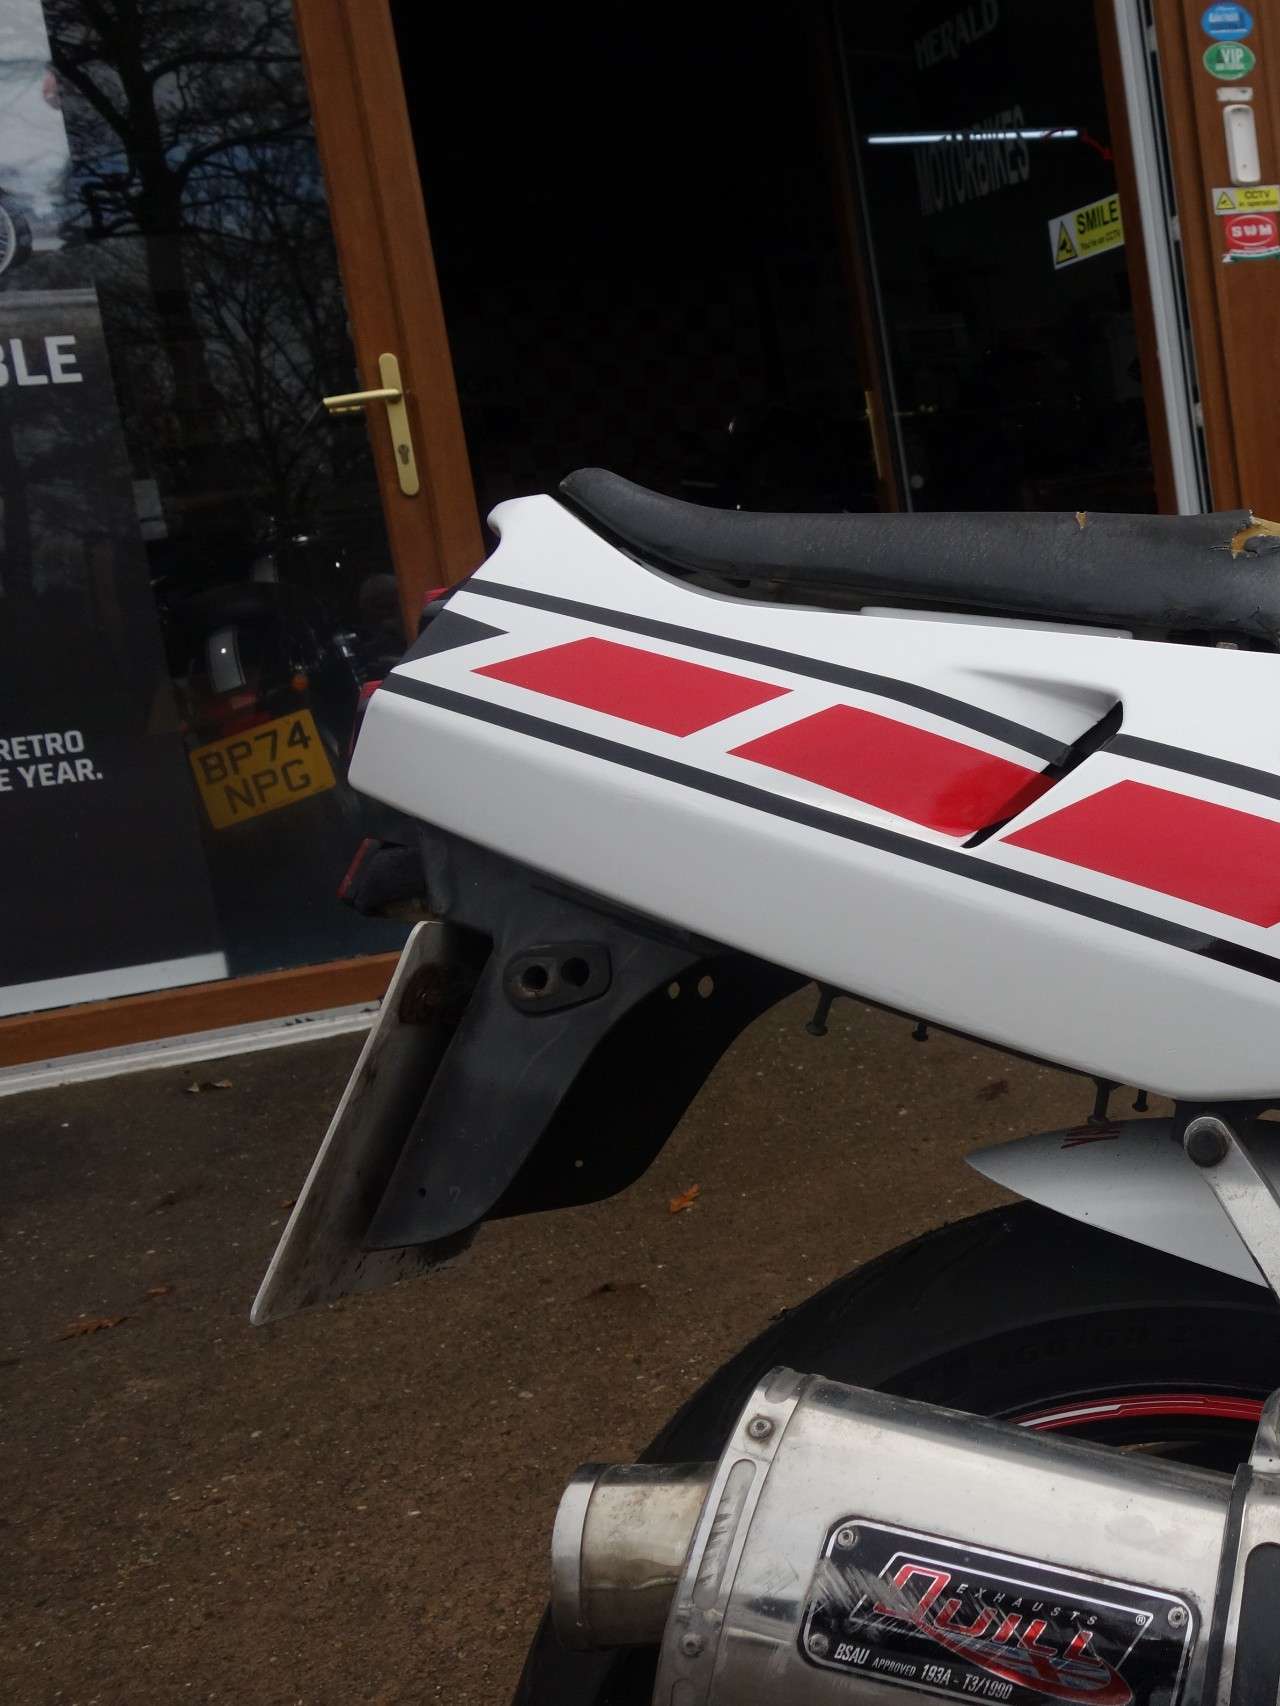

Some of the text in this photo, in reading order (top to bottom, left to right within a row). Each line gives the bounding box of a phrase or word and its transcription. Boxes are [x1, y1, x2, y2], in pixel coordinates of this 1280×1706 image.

[912, 0, 1000, 72] HERALD
[1221, 47, 1244, 64] VIP
[914, 104, 1031, 217] MOTORBIKES
[1244, 190, 1271, 200] CCTV
[1076, 200, 1119, 234] SMILE
[1231, 223, 1274, 238] SWM
[0, 335, 83, 387] LE
[17, 759, 104, 789] YEAR.
[198, 720, 311, 785] BP74
[224, 759, 312, 815] NPG
[955, 1583, 1099, 1626] EXHAUSTS
[834, 1643, 870, 1665] BSAU
[871, 1656, 917, 1677] APPROVED
[920, 1663, 952, 1686] 193A
